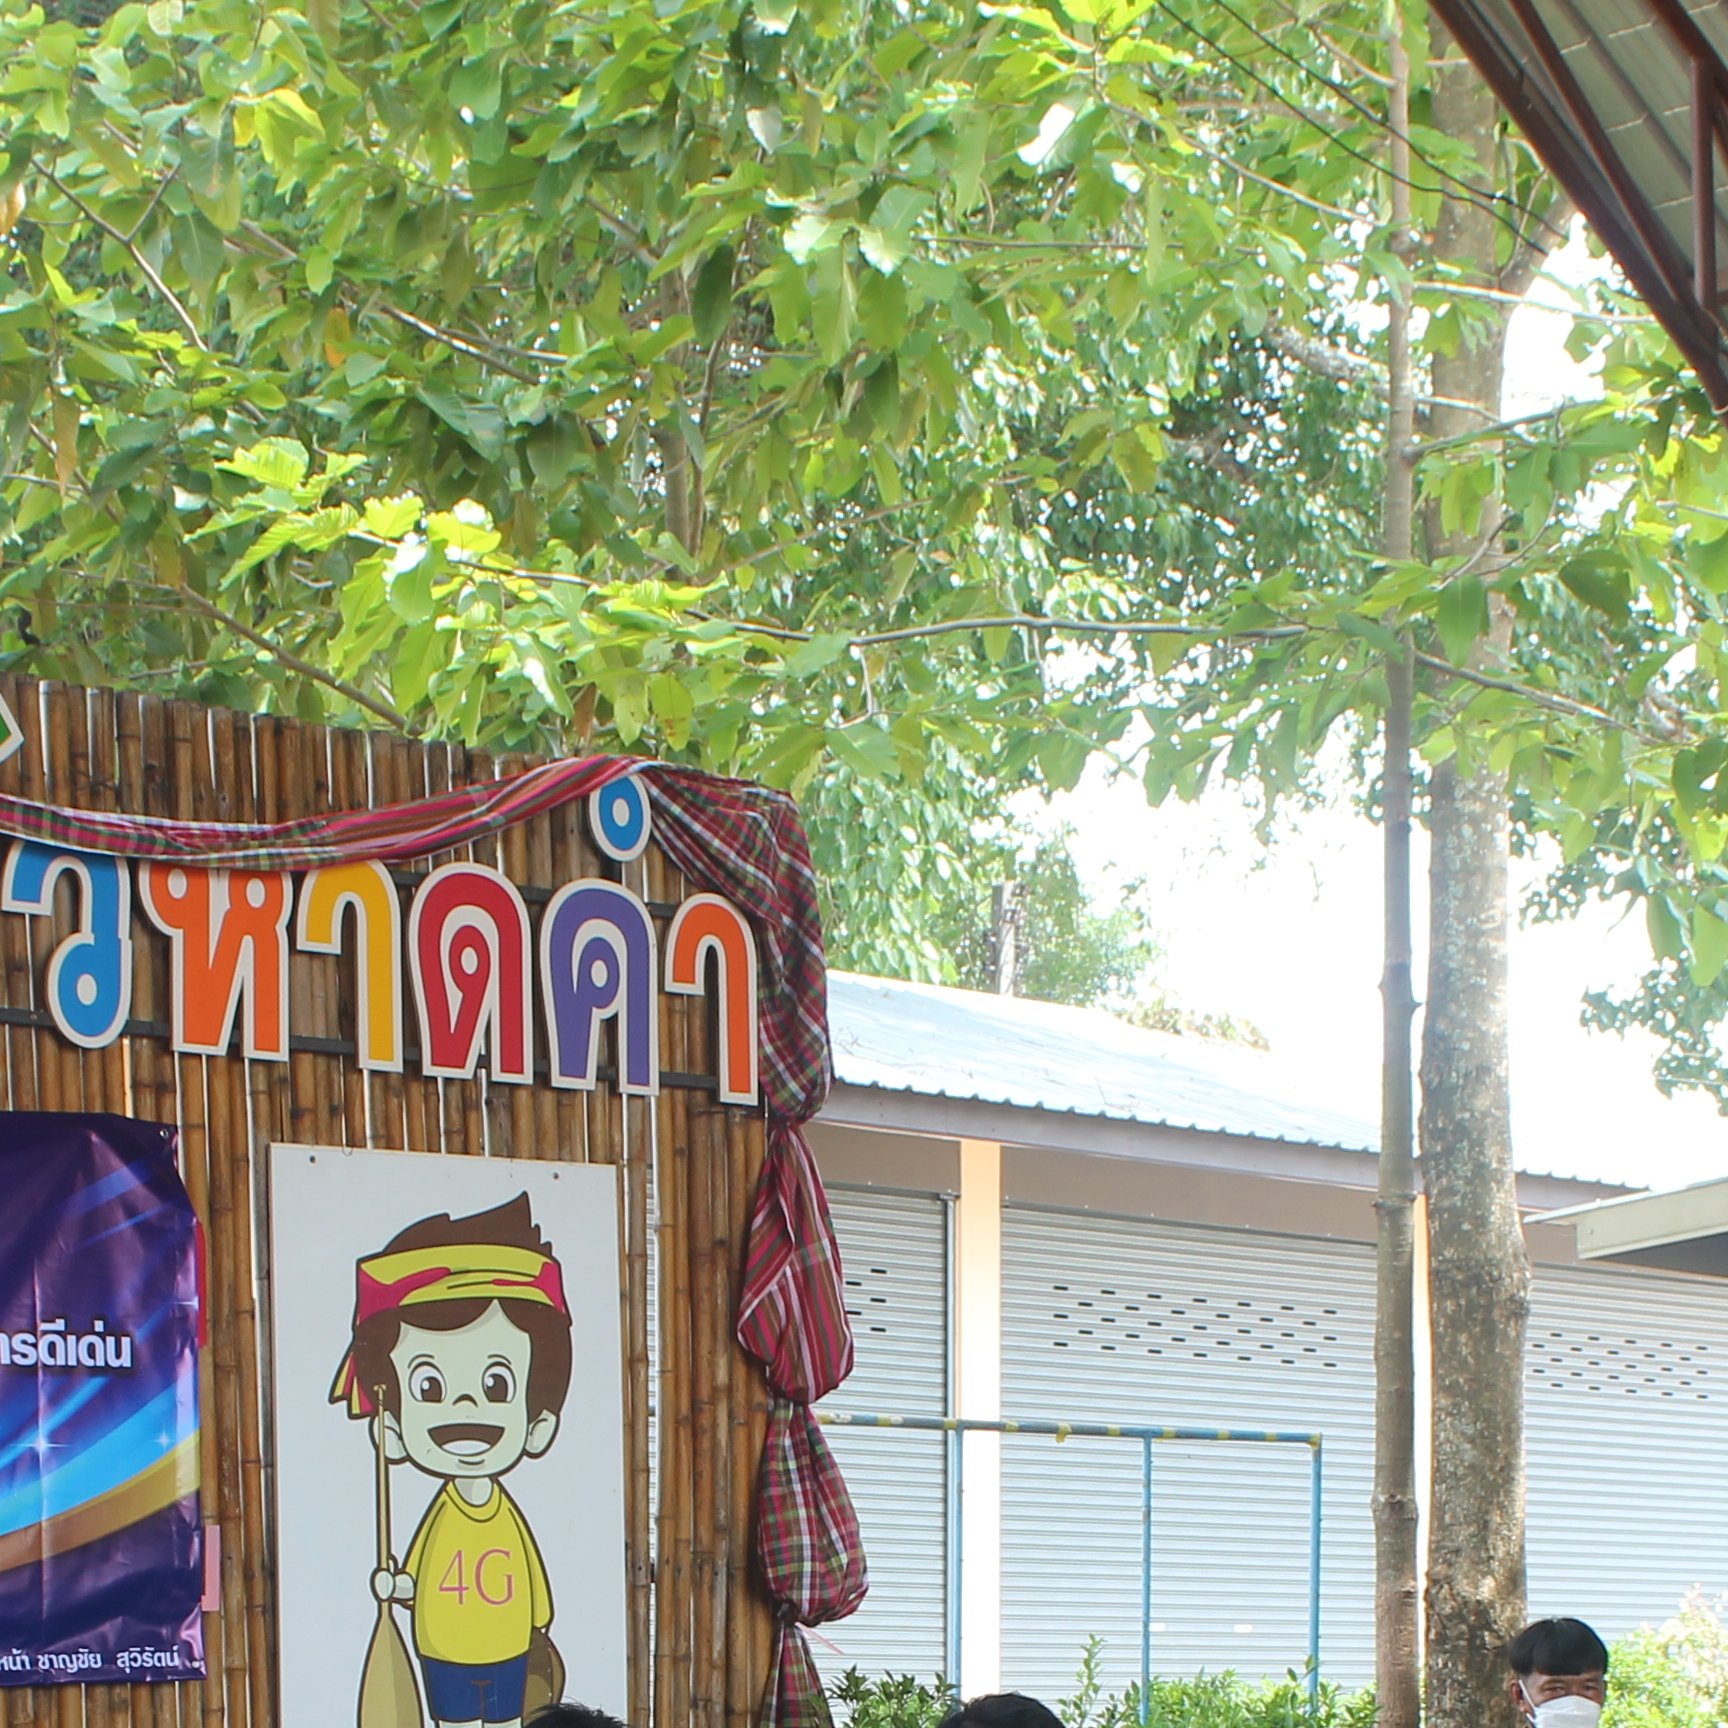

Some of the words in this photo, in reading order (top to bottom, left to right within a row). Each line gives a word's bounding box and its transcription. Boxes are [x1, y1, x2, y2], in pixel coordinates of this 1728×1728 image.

[438, 1549, 515, 1606] 4G
[37, 1648, 102, 1673] ชาญชัย
[116, 1644, 179, 1673] สุวิรัตน์
